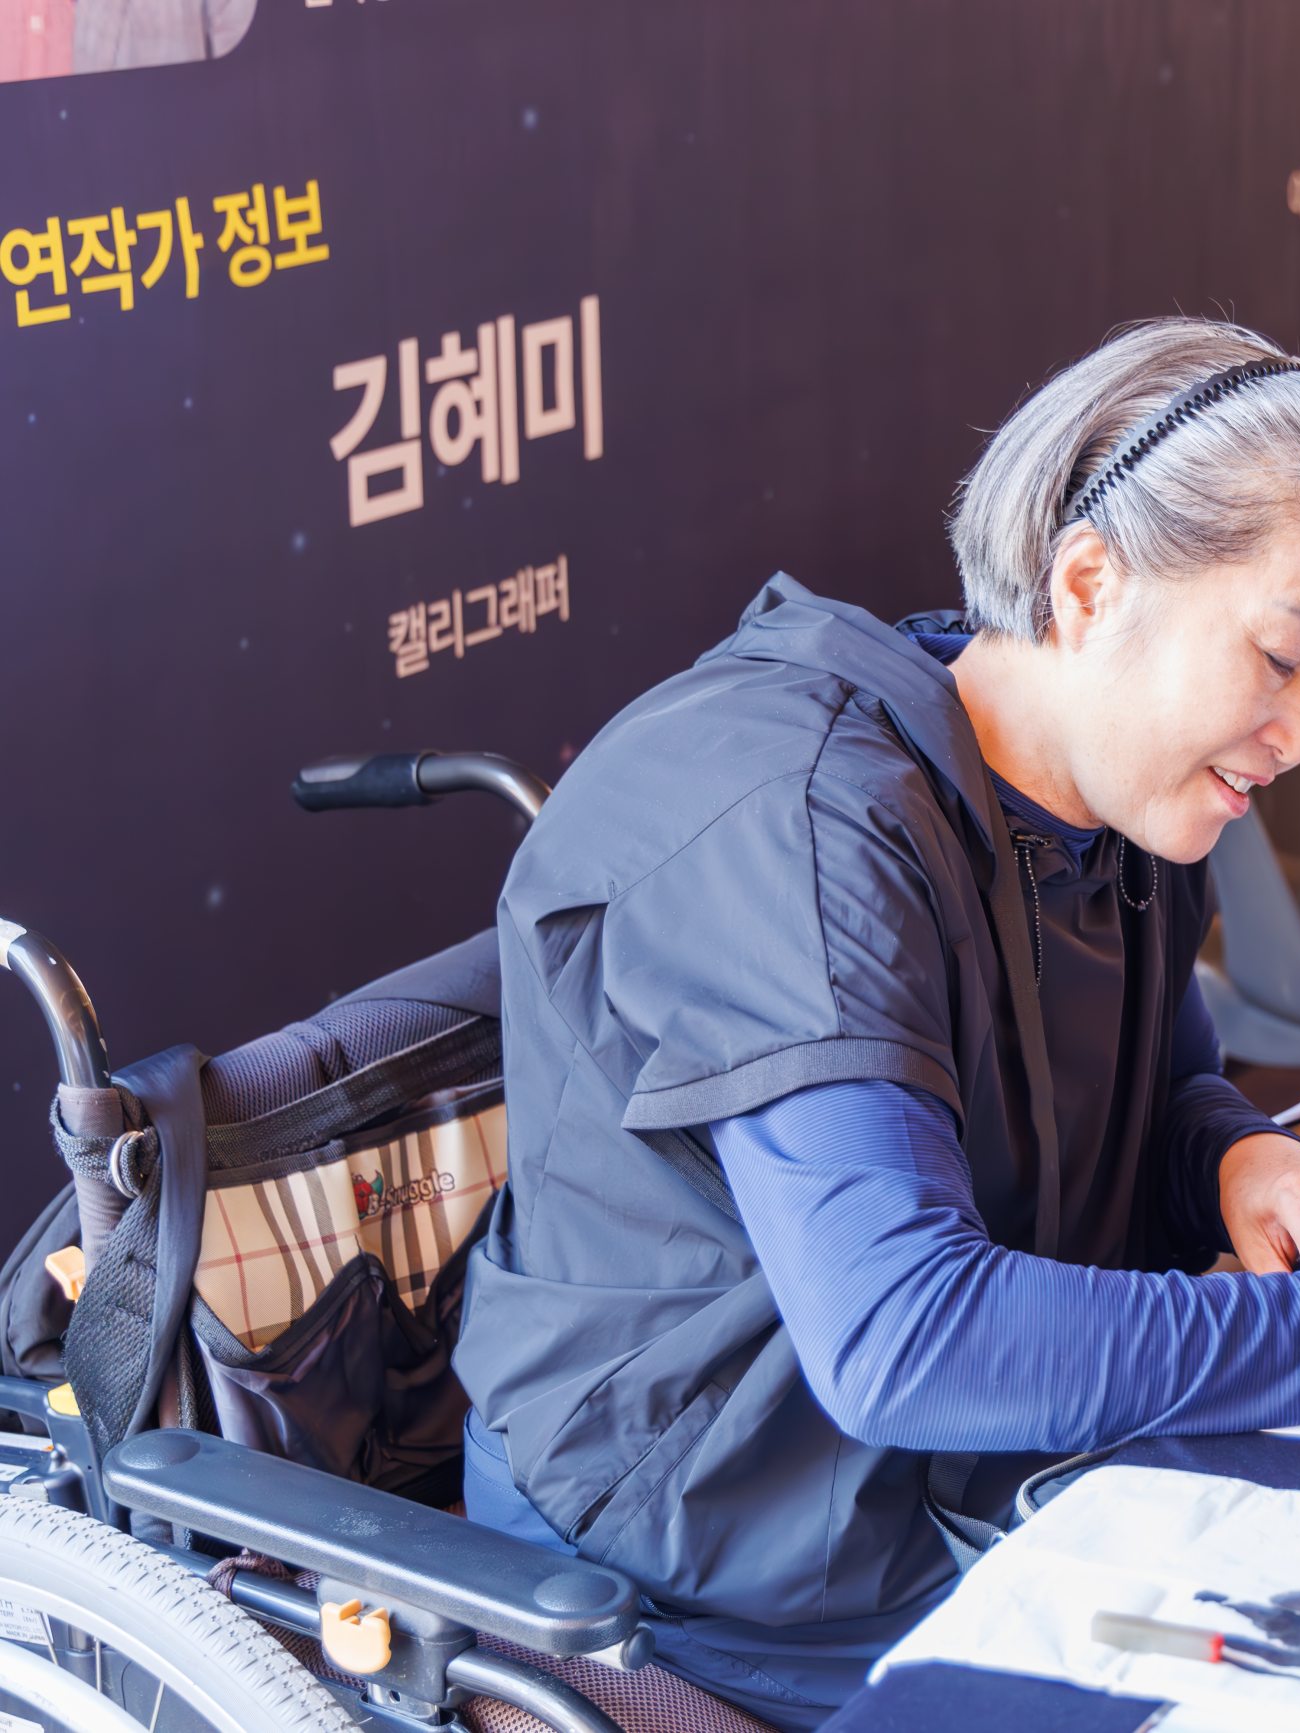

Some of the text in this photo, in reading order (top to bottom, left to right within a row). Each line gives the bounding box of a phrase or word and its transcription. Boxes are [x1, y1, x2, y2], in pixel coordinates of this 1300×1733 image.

[0, 179, 330, 328] 연작가 정보
[329, 294, 604, 528] 김혜미
[388, 555, 570, 679] 캘리그래퍼
